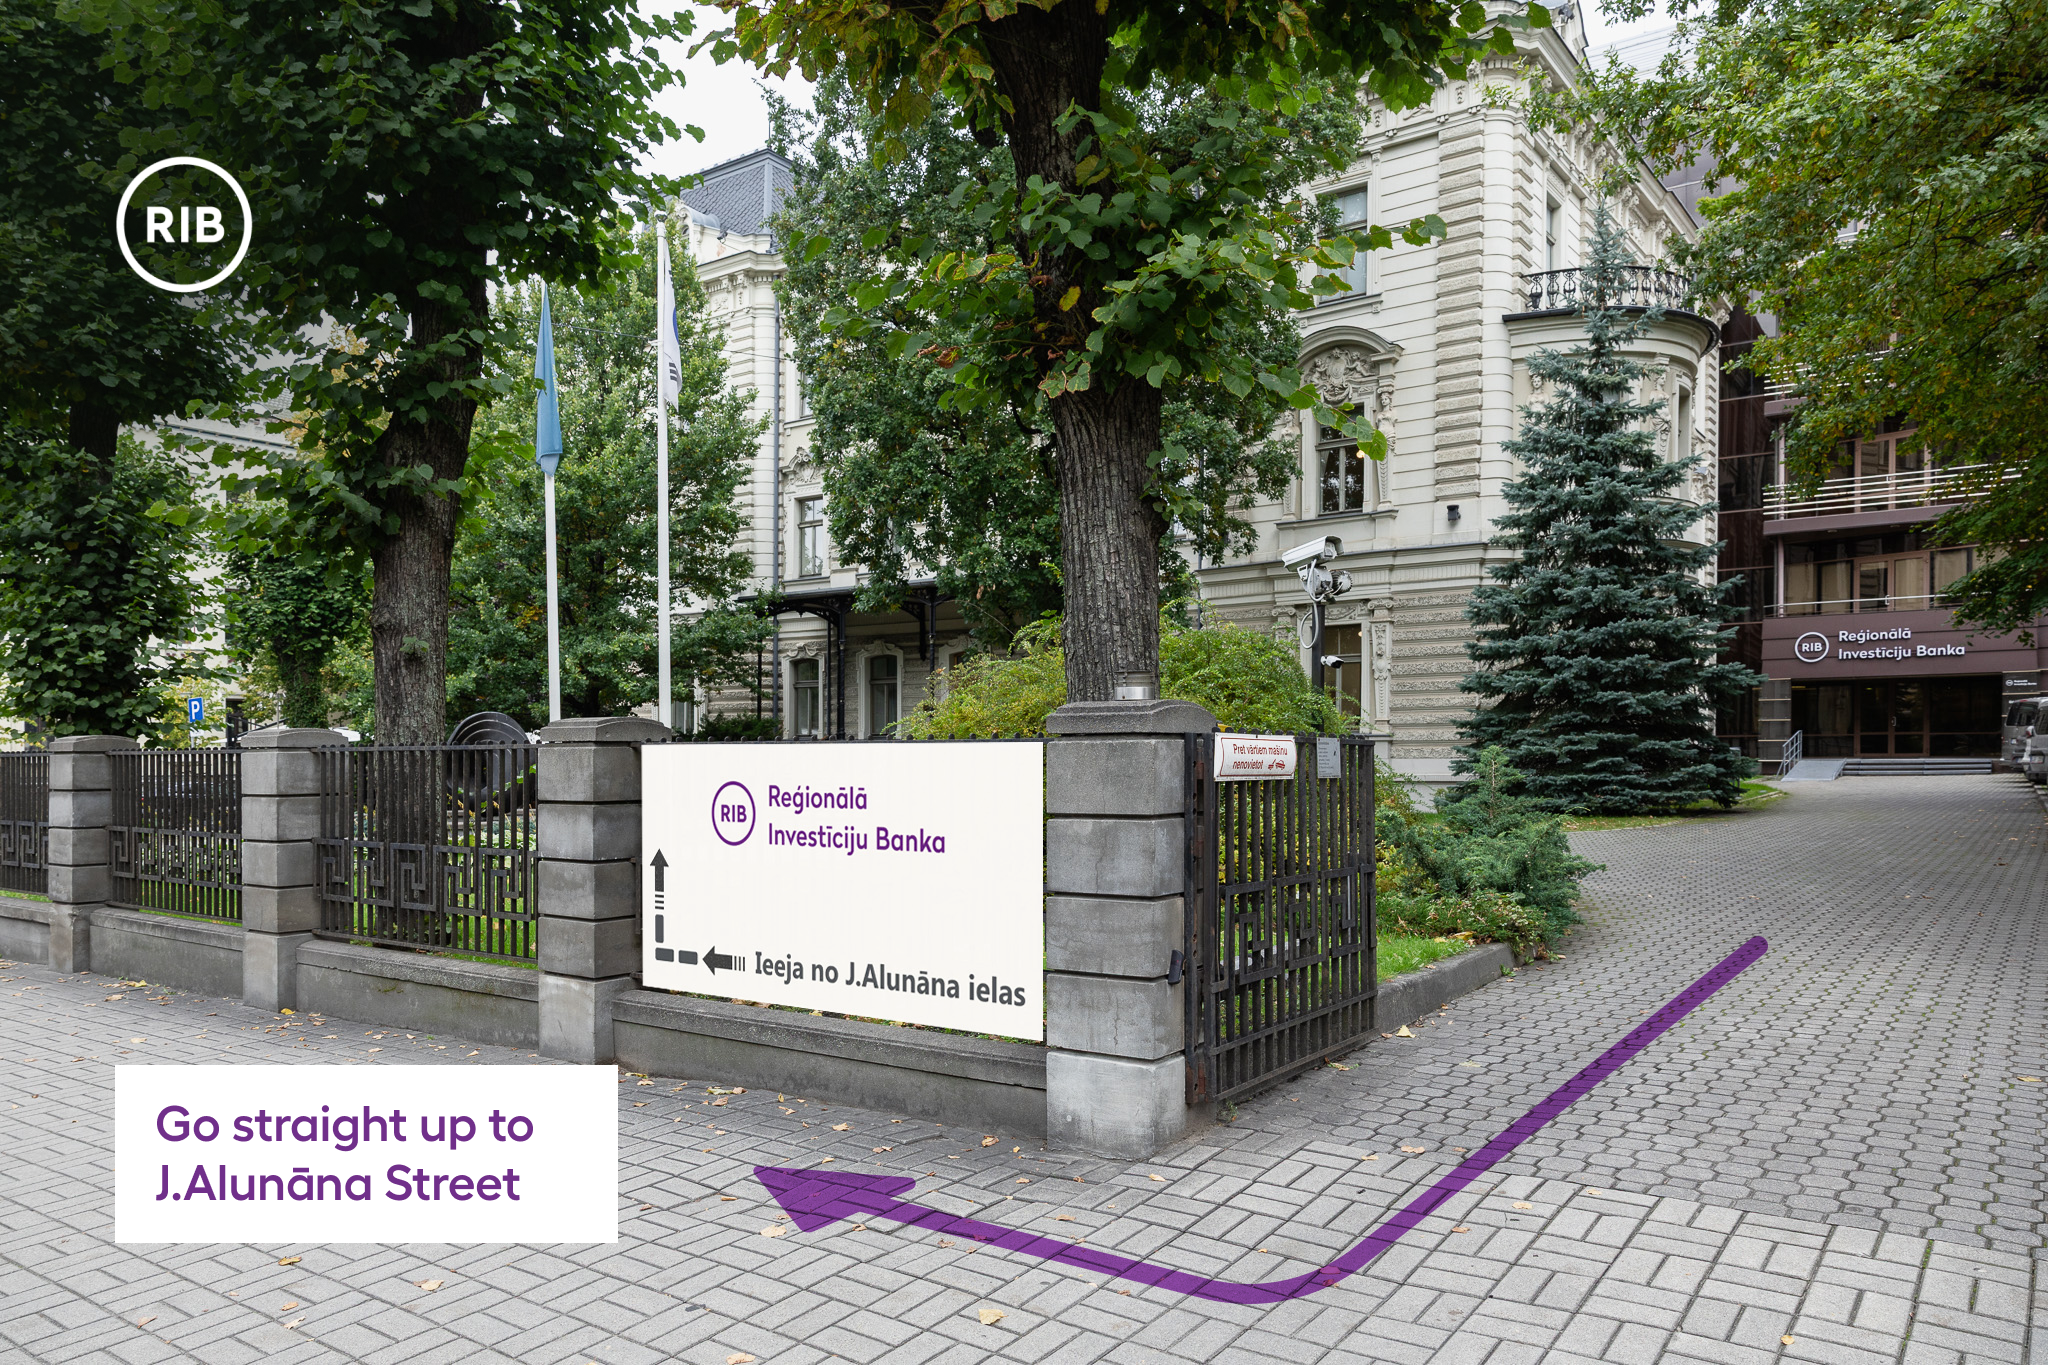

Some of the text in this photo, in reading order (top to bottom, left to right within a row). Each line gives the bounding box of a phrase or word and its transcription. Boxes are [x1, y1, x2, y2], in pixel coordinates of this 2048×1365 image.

[1838, 627, 1912, 645] Reģionālā
[1801, 642, 1823, 653] RIB
[1838, 644, 1966, 662] Investīciju Banka
[191, 700, 200, 720] P
[1233, 743, 1246, 755] Pret
[1232, 758, 1264, 770] nenovietot
[768, 784, 868, 815] Reģionālā
[720, 804, 747, 823] RIB
[768, 822, 946, 856] Investīciju Banka
[755, 951, 1026, 1007] Ieeja no J.Alunāna ielas
